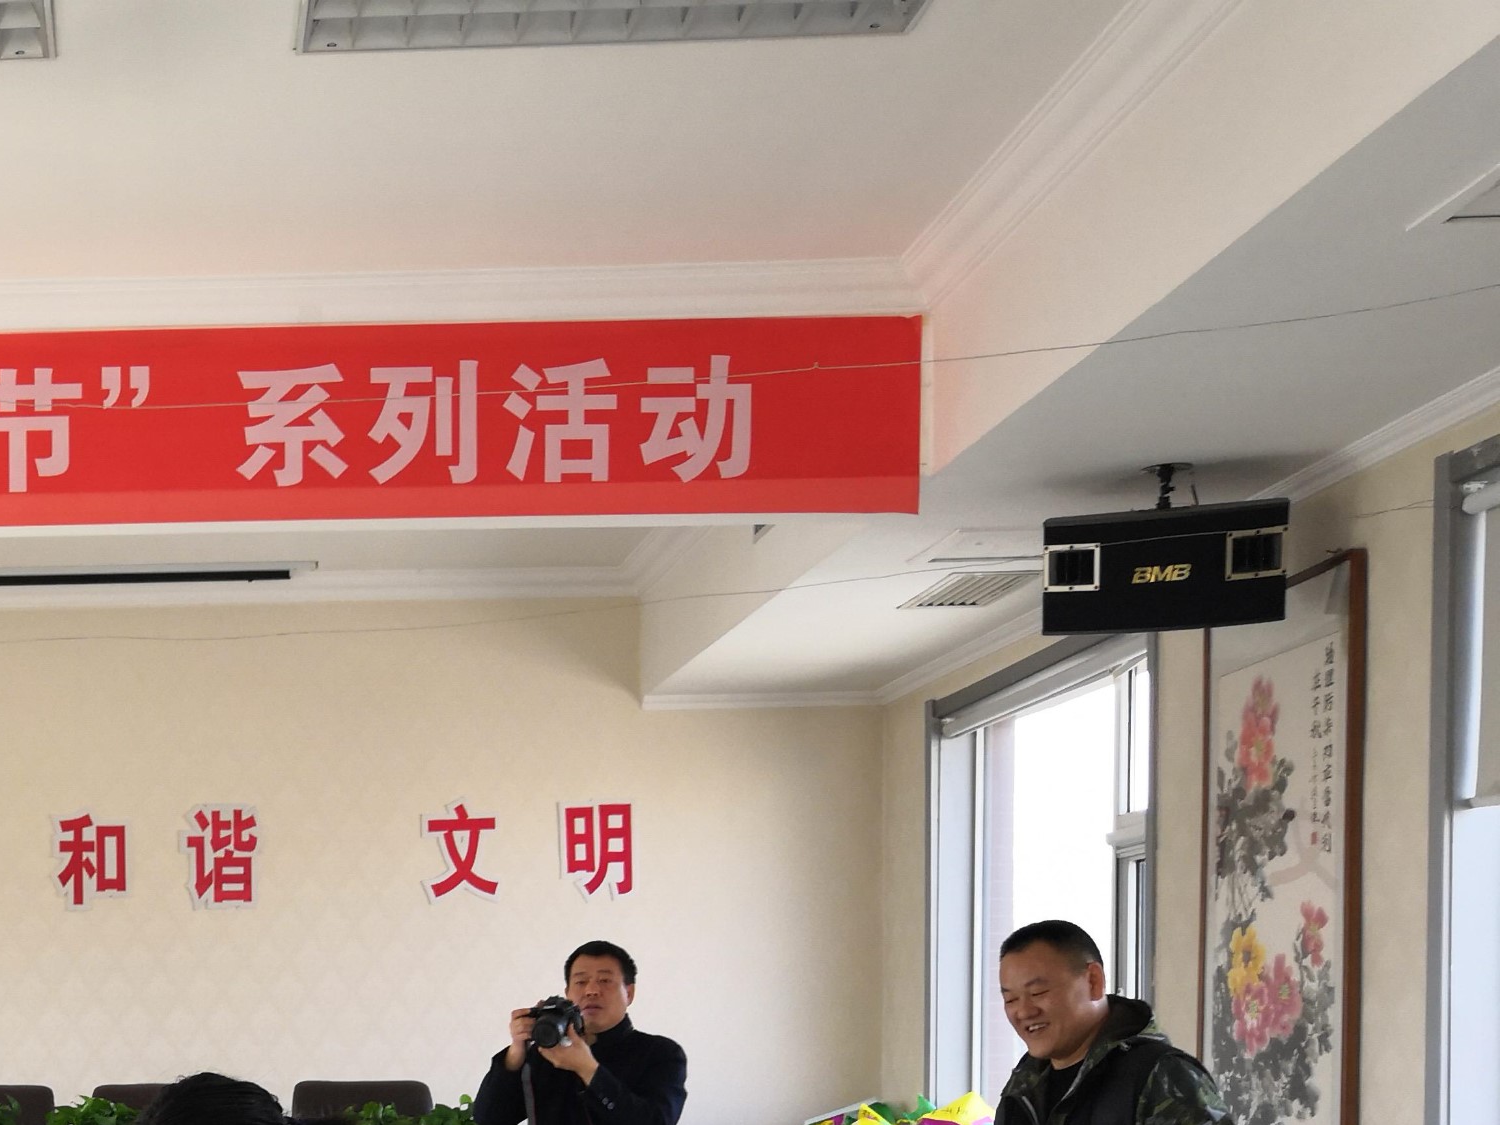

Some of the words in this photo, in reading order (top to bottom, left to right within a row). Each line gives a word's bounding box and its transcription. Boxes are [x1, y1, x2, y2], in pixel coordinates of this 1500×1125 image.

[236, 354, 755, 487] 系列活动
[1131, 563, 1192, 585] BMB
[57, 809, 257, 905] 和谐
[427, 803, 633, 897] 文明
